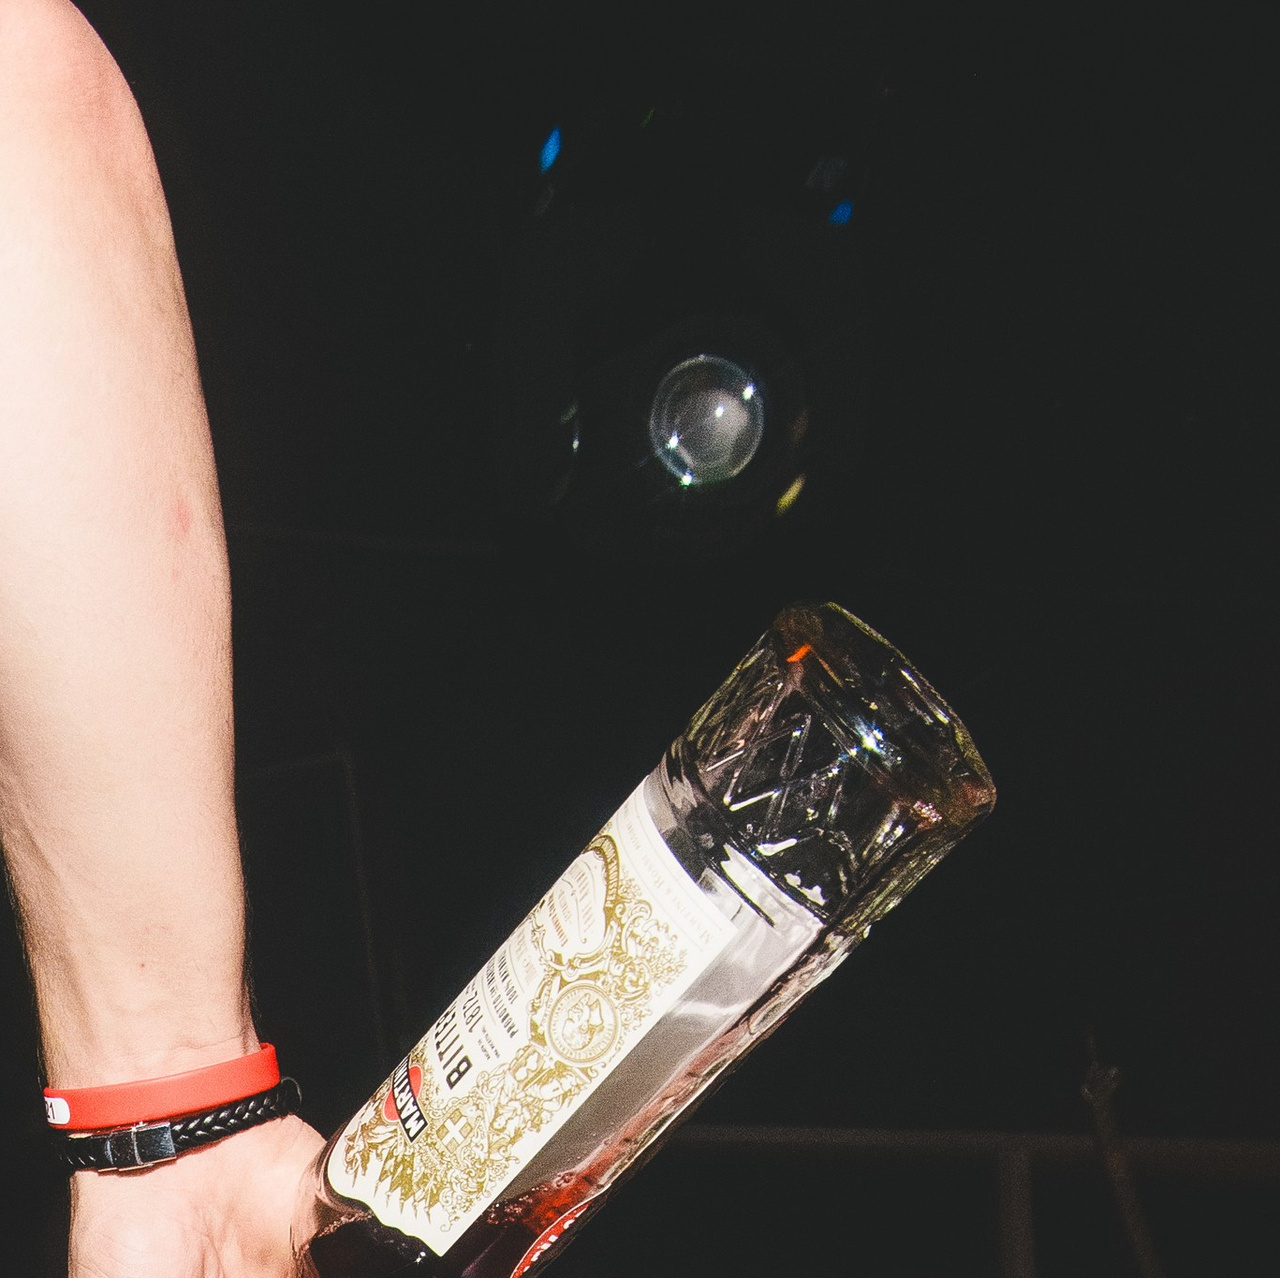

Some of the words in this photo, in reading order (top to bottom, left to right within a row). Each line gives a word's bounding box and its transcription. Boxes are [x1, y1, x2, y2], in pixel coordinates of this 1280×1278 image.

[433, 1000, 473, 1090] BITTER
[461, 989, 483, 1032] 1872
[391, 1056, 426, 1138] MARTINI
